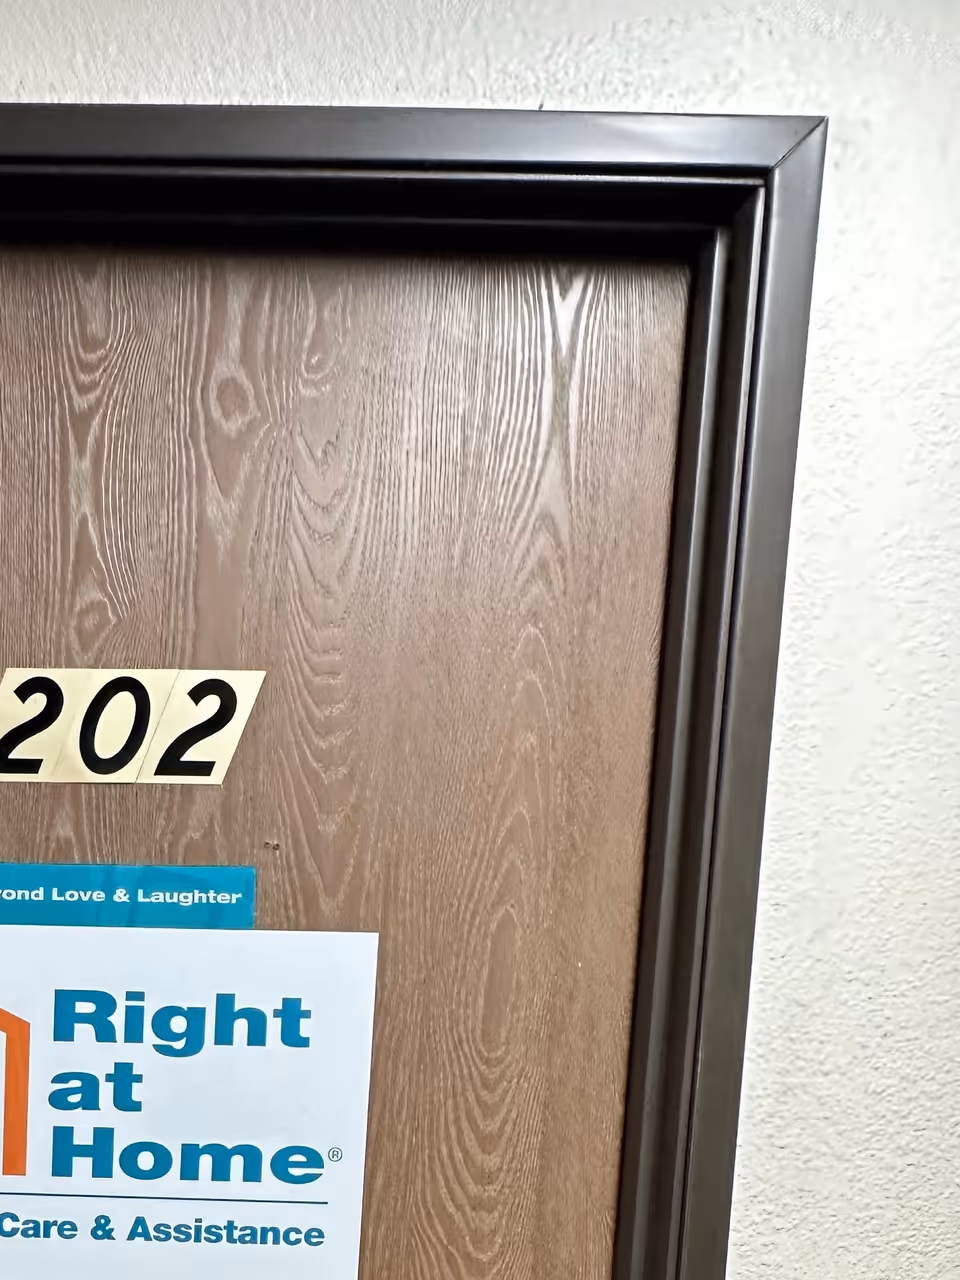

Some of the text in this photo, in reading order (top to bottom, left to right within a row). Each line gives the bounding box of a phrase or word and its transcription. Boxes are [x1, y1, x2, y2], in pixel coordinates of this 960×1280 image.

[51, 886, 105, 903] Love
[114, 887, 130, 903] &
[137, 888, 242, 906] Laughter
[53, 989, 312, 1057] Right
[48, 1062, 143, 1112] at
[90, 1215, 116, 1241] &
[126, 1217, 325, 1246] Assistance
